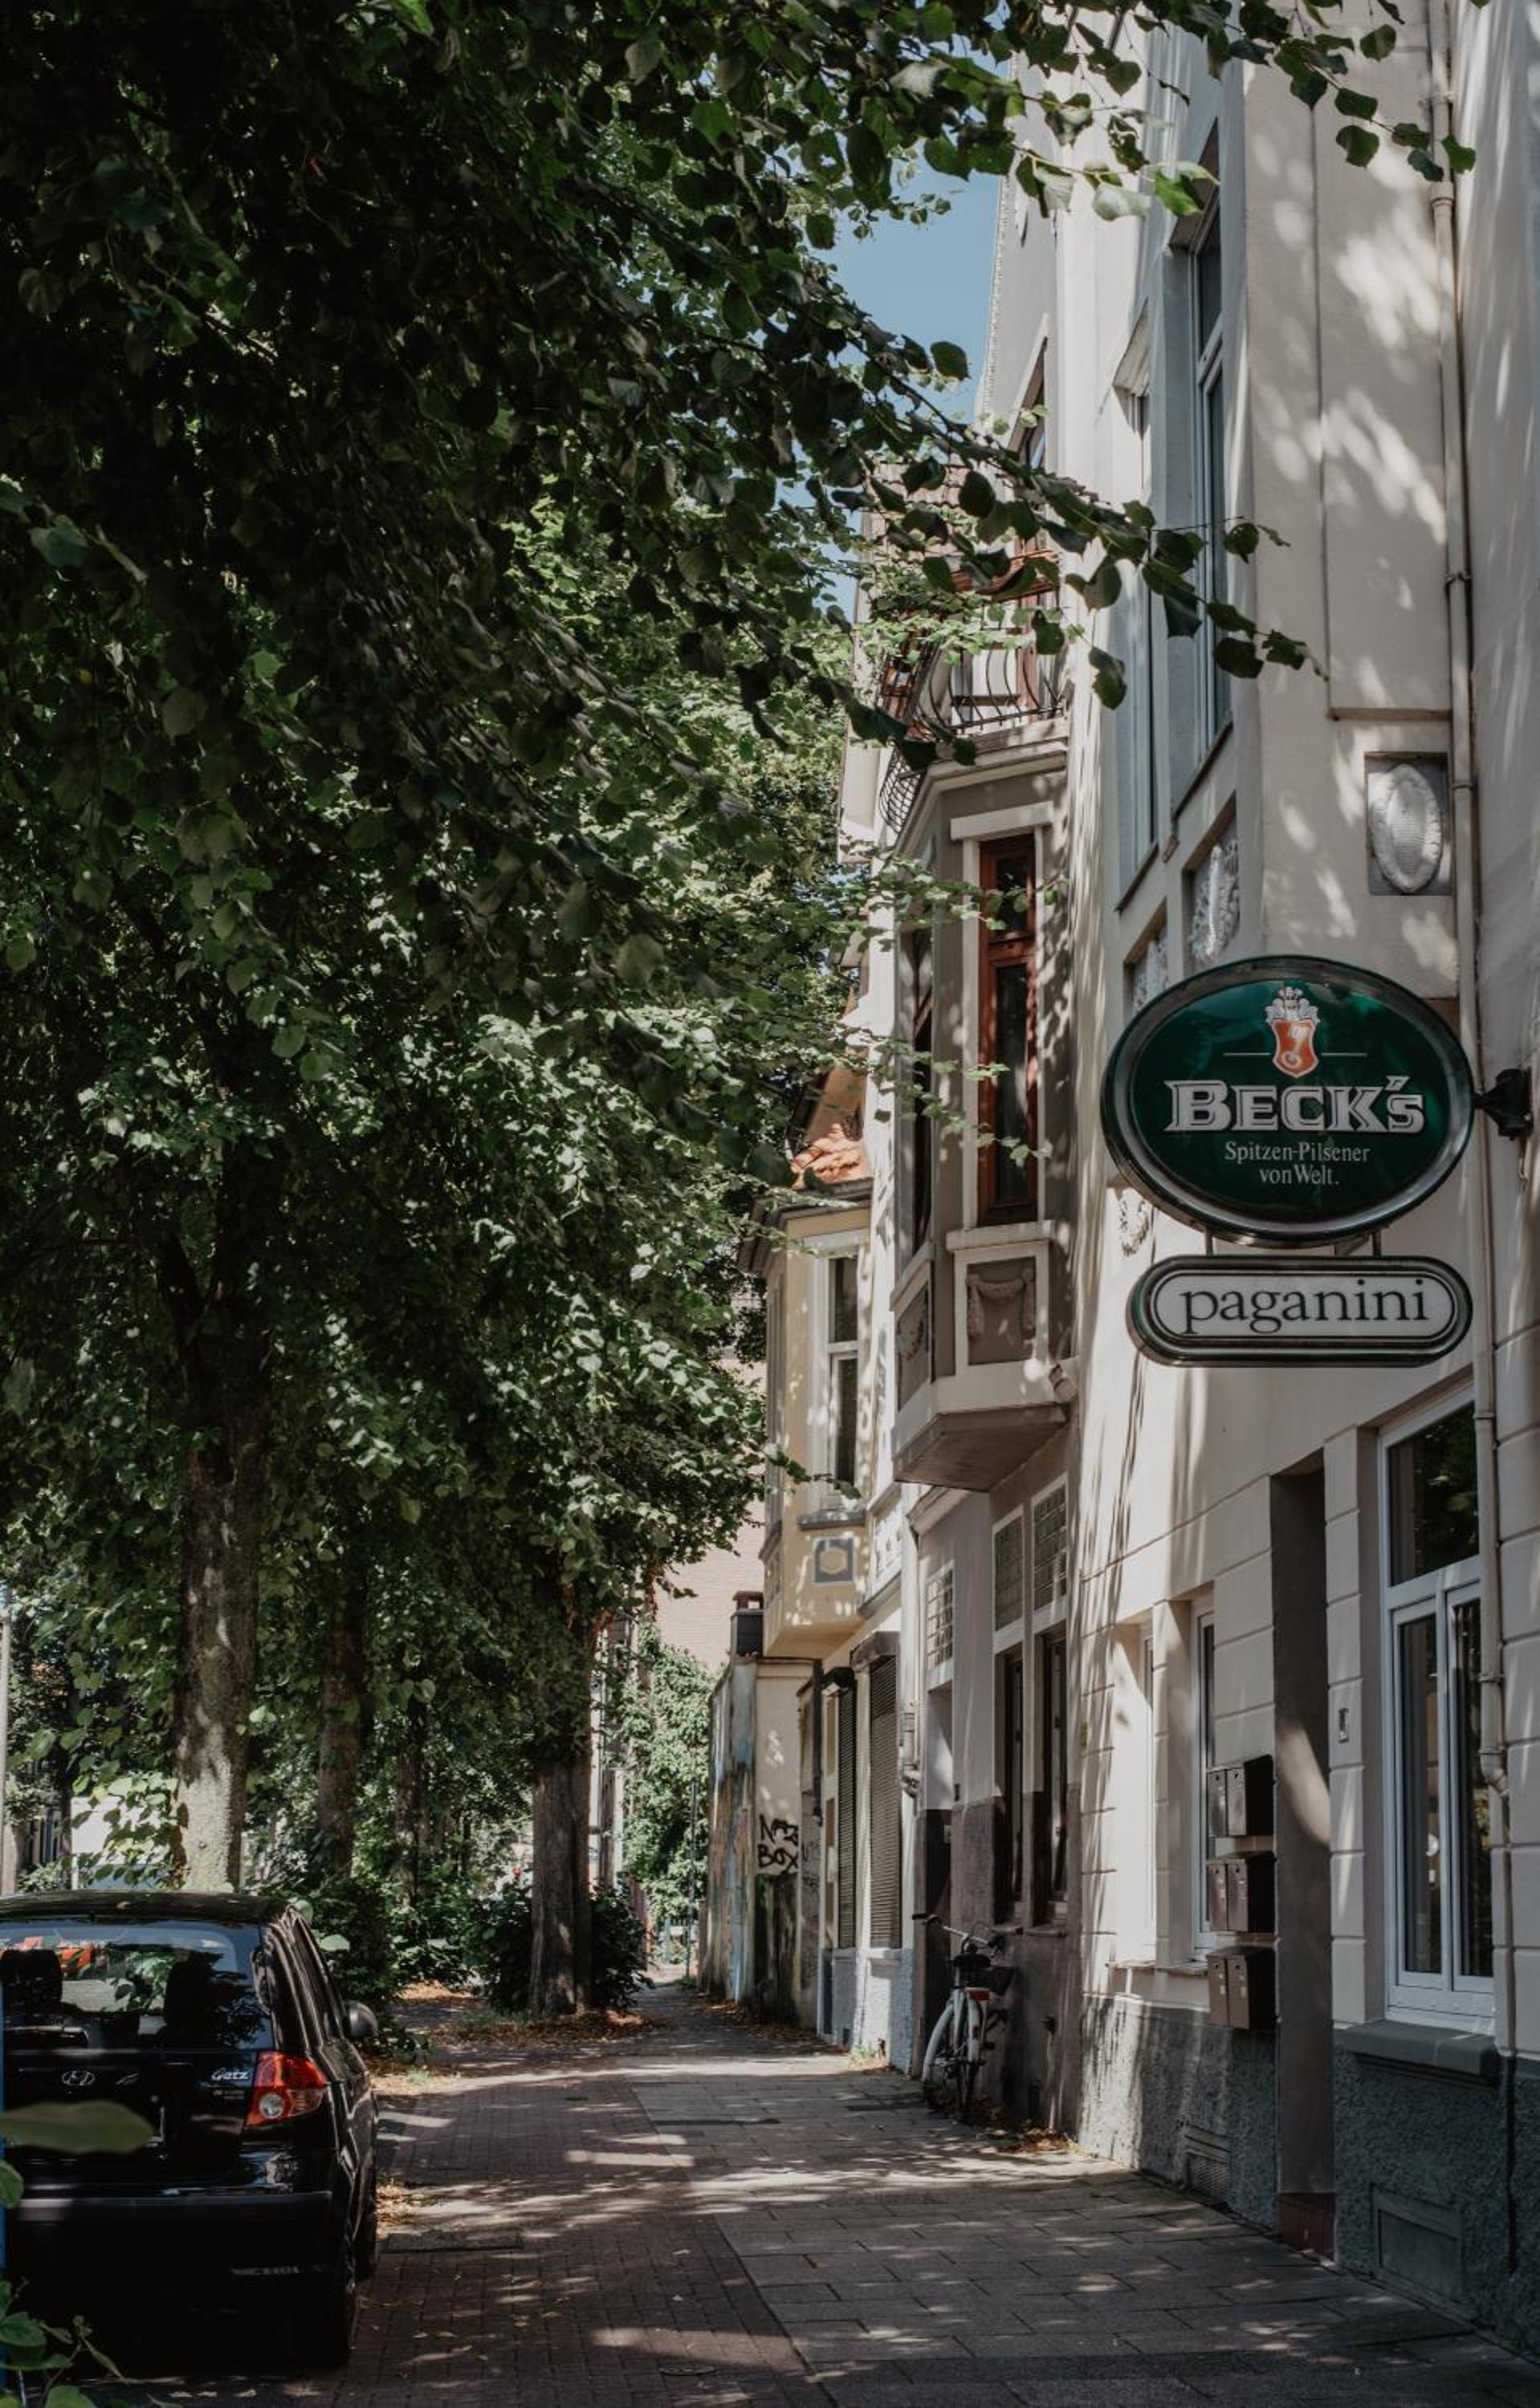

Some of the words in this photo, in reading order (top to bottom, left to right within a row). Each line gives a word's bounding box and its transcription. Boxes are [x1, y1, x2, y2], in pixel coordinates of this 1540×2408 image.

[1224, 1141, 1371, 1163] Spitzen-Pilsener
[1259, 1169, 1292, 1184] von
[1294, 1165, 1340, 1185] Welt.
[1181, 1279, 1429, 1335] paganini
